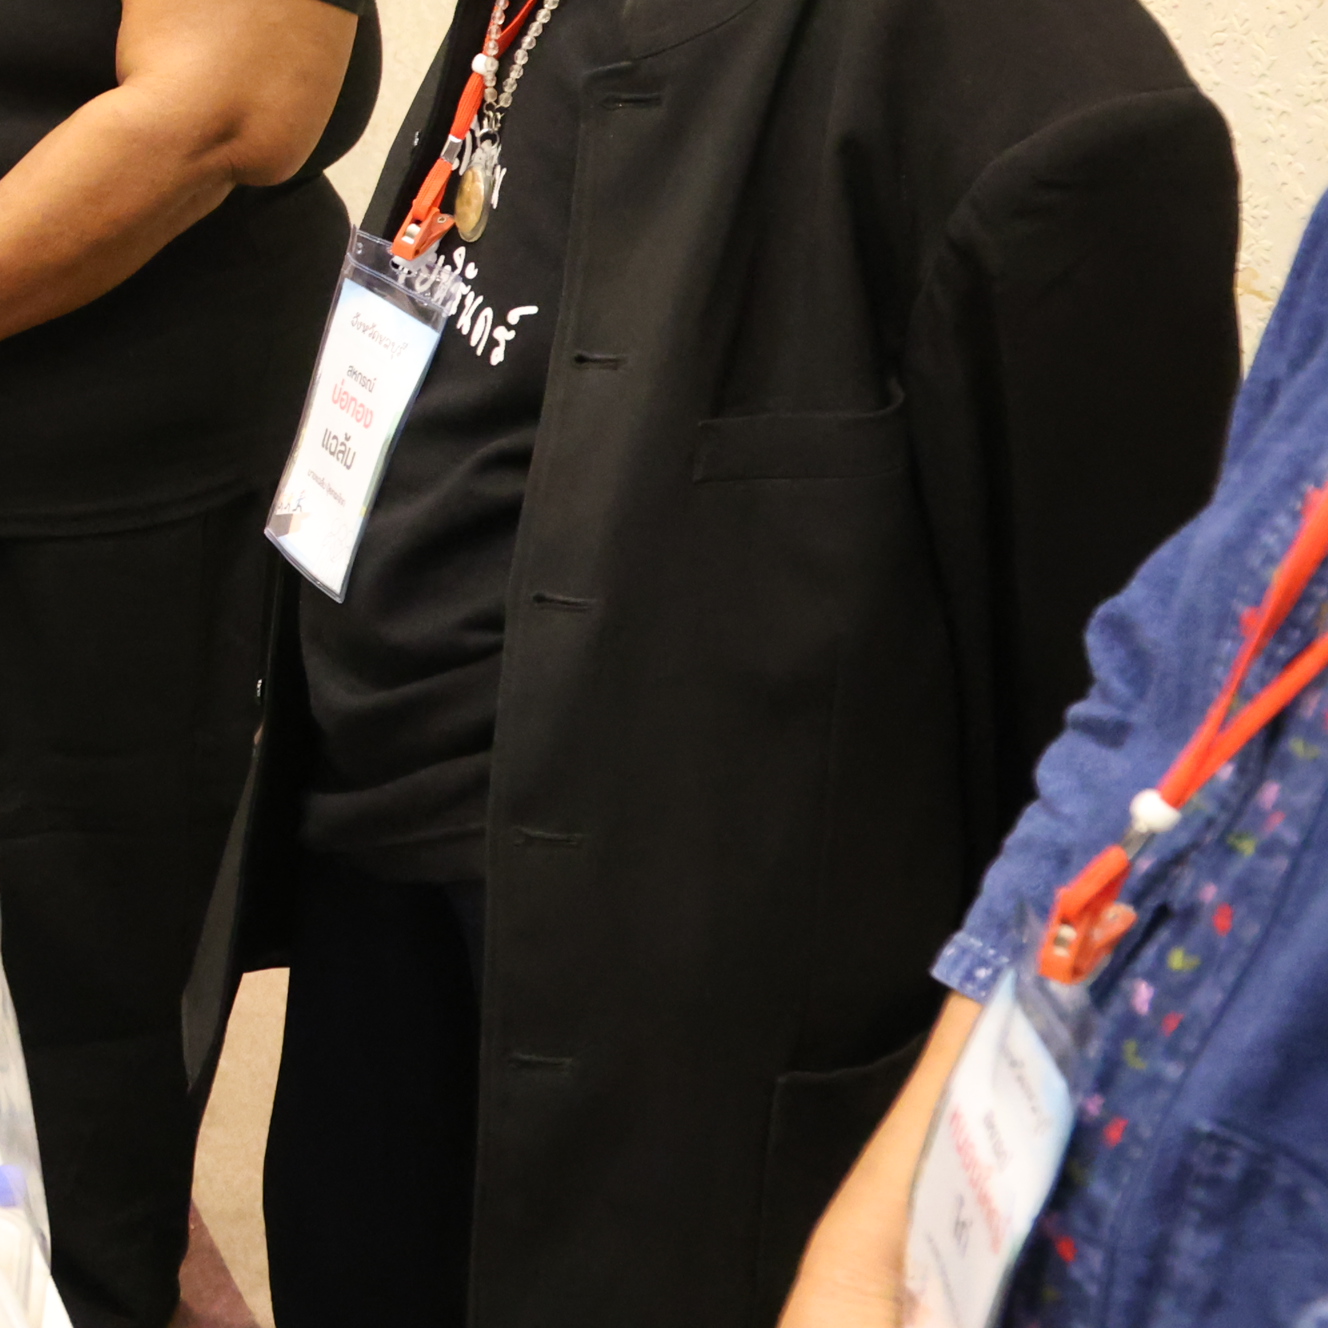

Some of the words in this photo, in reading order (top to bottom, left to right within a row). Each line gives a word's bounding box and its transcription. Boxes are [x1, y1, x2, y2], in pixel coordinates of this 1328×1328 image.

[346, 365, 377, 393] สหกรณ์
[331, 378, 374, 429] บ่อทอง
[321, 427, 357, 470] แฉล้ม
